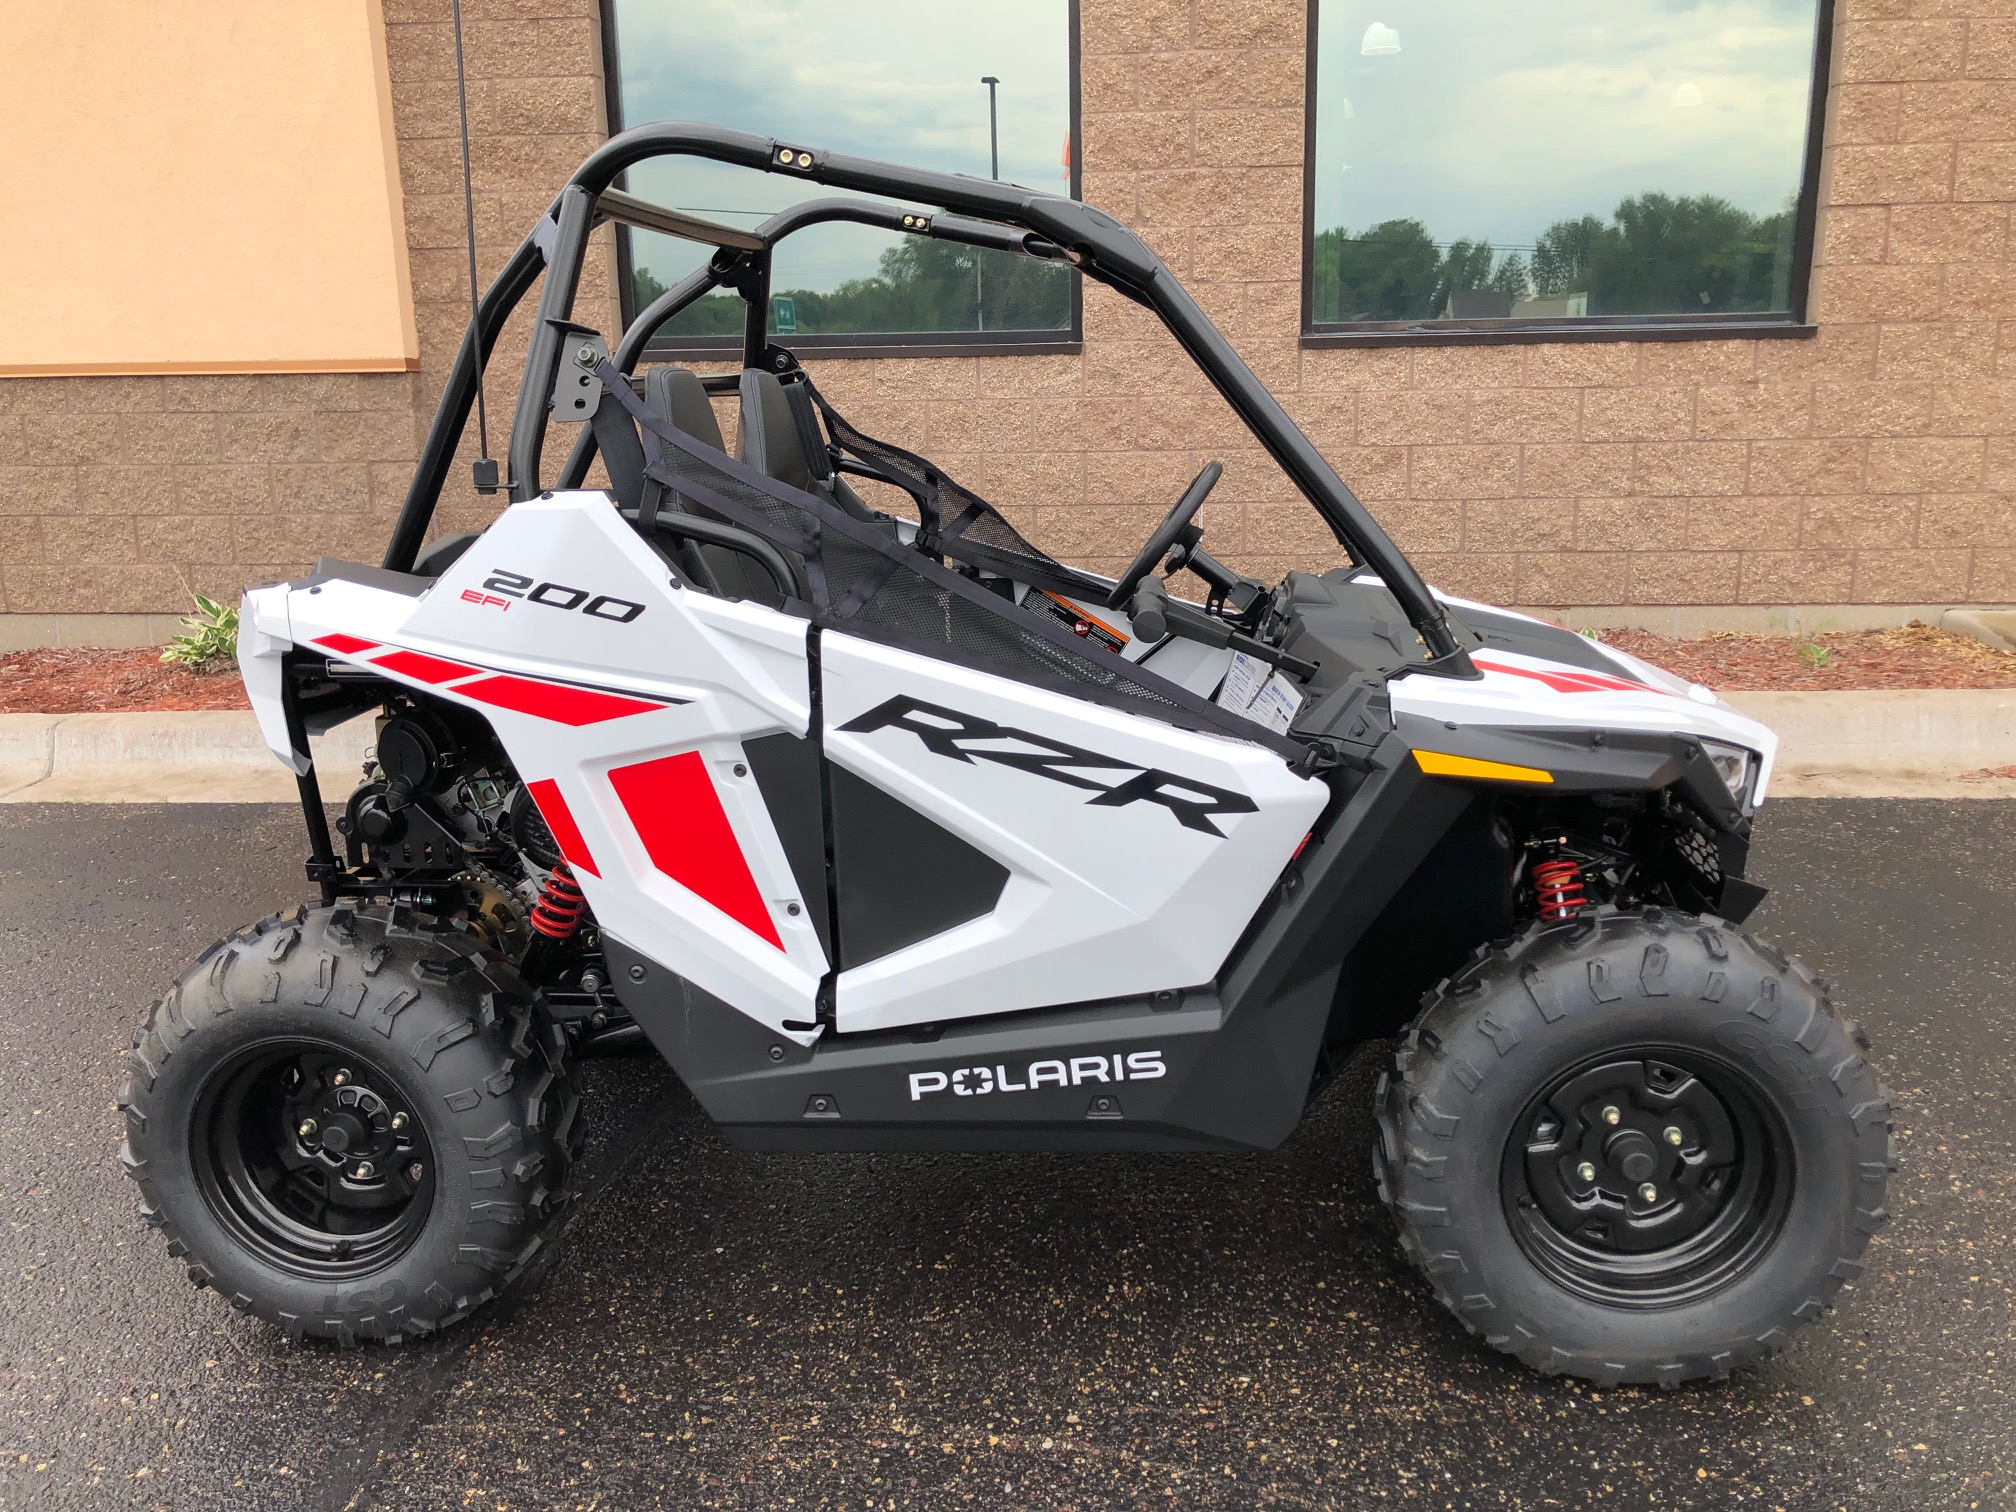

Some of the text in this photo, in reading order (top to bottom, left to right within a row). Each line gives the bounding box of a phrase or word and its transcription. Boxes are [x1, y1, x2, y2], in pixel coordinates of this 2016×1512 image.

[460, 589, 511, 612] EFI
[482, 568, 646, 623] 200
[833, 694, 1260, 839] RZR
[908, 1050, 1167, 1101] POLARIS
